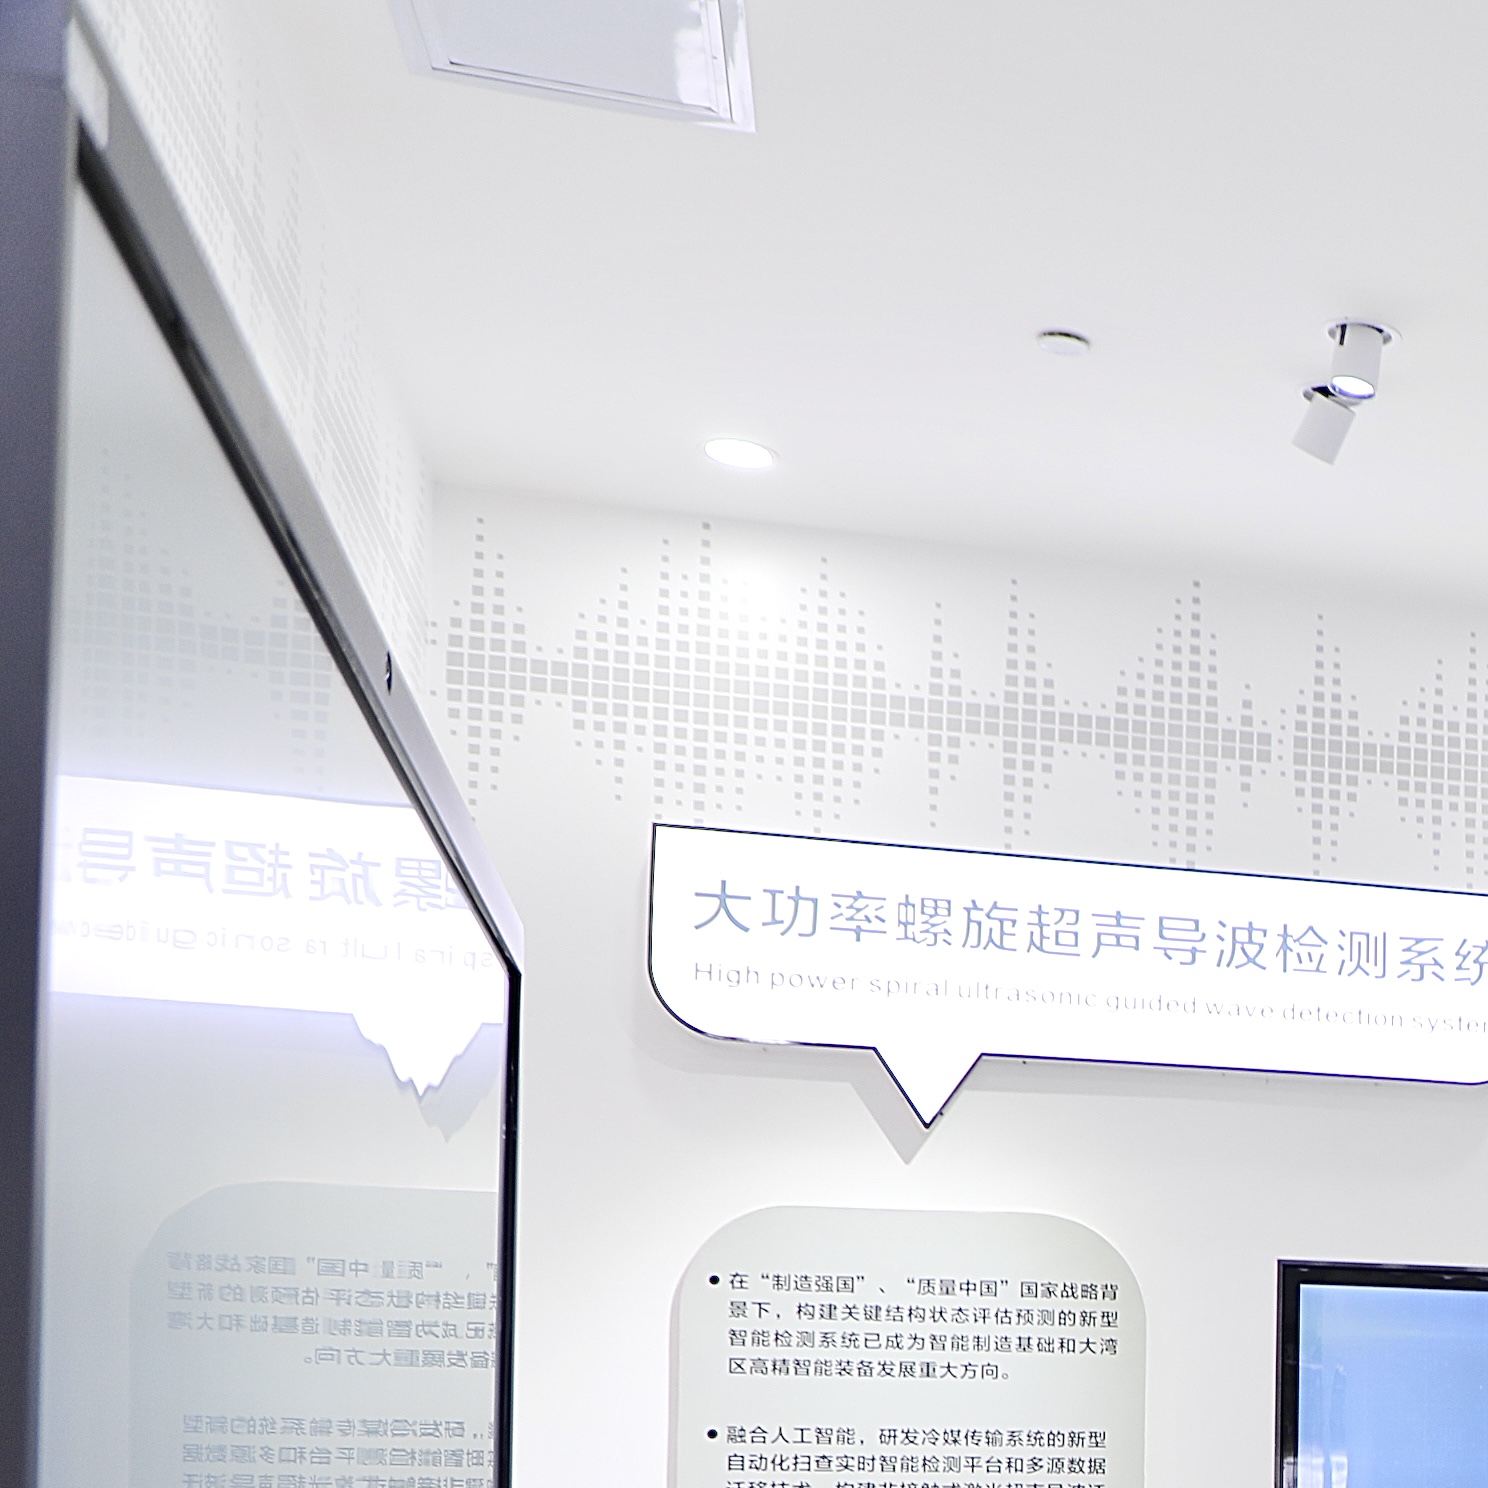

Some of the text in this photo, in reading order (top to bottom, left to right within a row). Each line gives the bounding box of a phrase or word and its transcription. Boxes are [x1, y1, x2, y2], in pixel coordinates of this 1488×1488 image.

[694, 962, 761, 988] High
[770, 972, 860, 990] power
[869, 976, 948, 997] spiral
[957, 981, 1097, 1008] ultrasonic
[1105, 993, 1196, 1014] guided
[1206, 1000, 1274, 1020] wave
[1282, 1004, 1403, 1028] detection
[728, 1328, 1118, 1356] 智能检测系统已成为智能制造基础和大湾
[728, 1357, 1010, 1381] 区高精智能装备发展重大方向。
[727, 1453, 1106, 1475] 自动化扫查实时智能检测平台和多源数据
